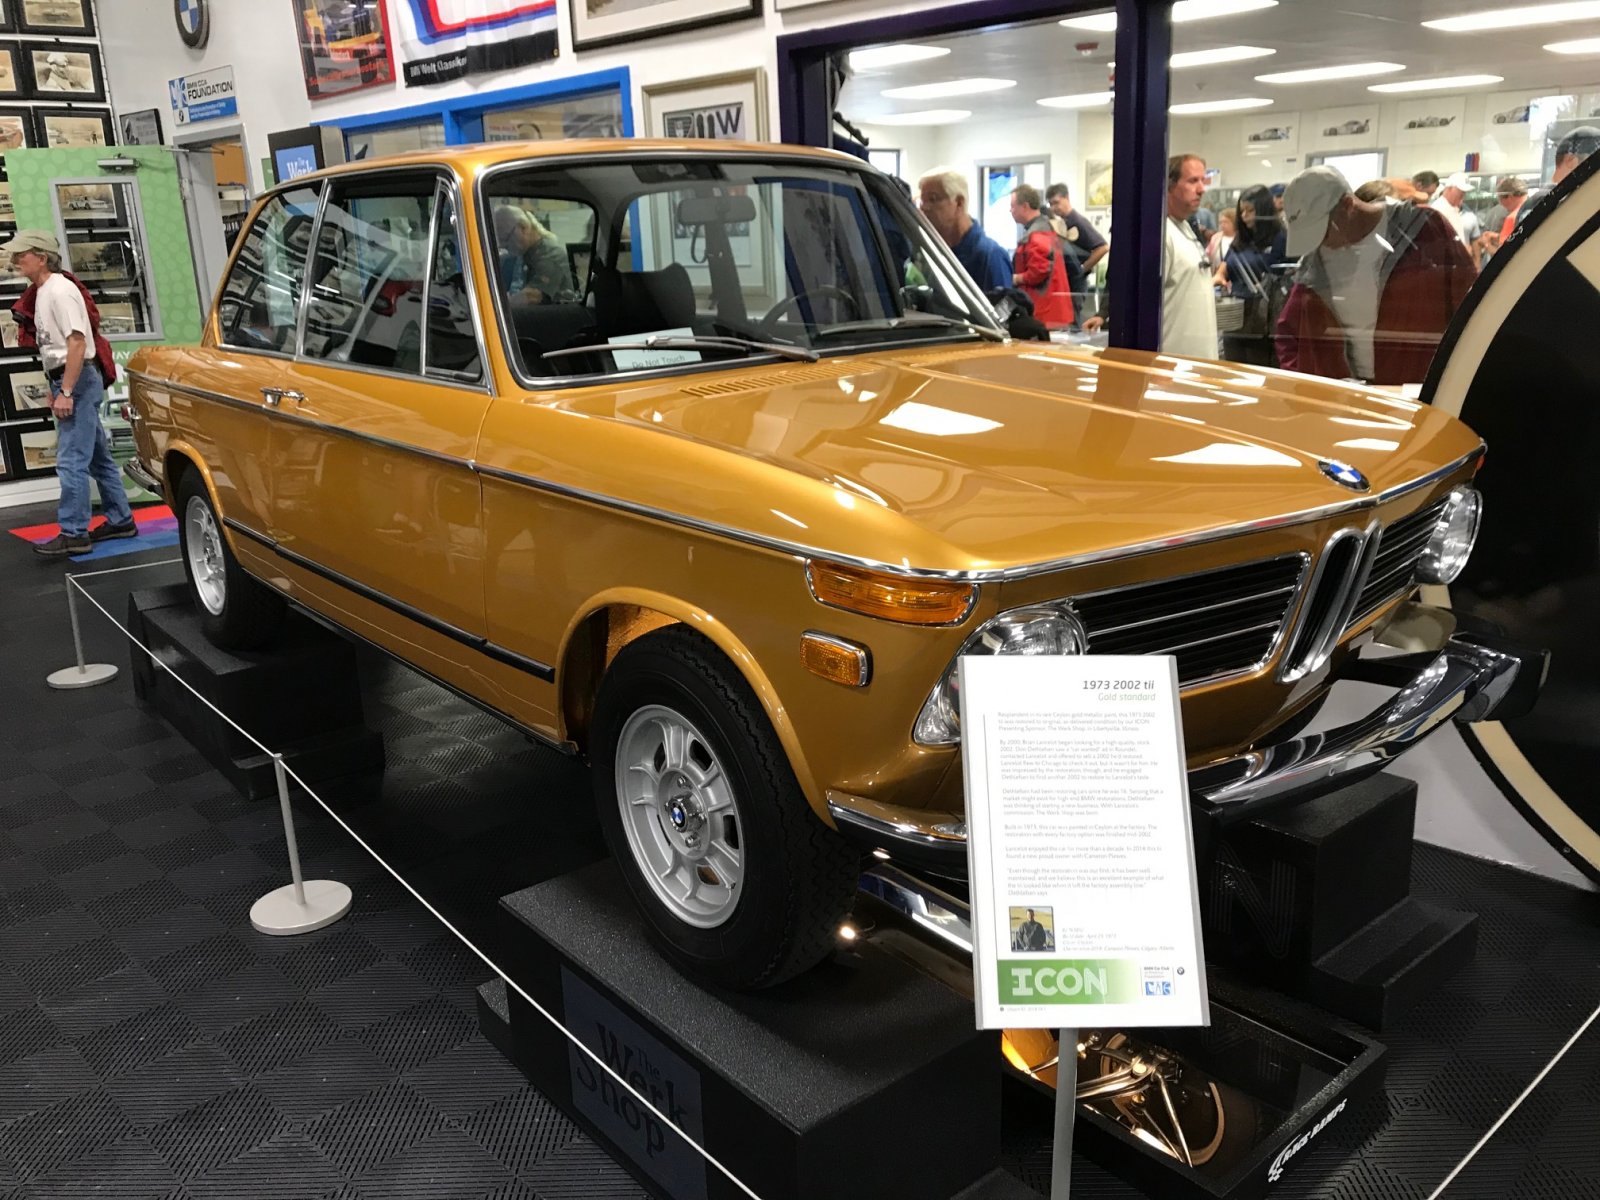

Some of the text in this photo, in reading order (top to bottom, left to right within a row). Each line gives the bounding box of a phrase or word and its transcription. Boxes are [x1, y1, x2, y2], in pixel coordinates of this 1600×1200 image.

[188, 81, 233, 100] FOUNDATION
[646, 358, 660, 367] Not
[662, 354, 686, 364] Touch
[1083, 680, 1155, 690] 1973 2002 tii
[1098, 692, 1156, 701] Gold standard
[1011, 967, 1108, 996] ICON
[596, 1022, 688, 1135] Werk
[575, 1046, 665, 1158] Shop
